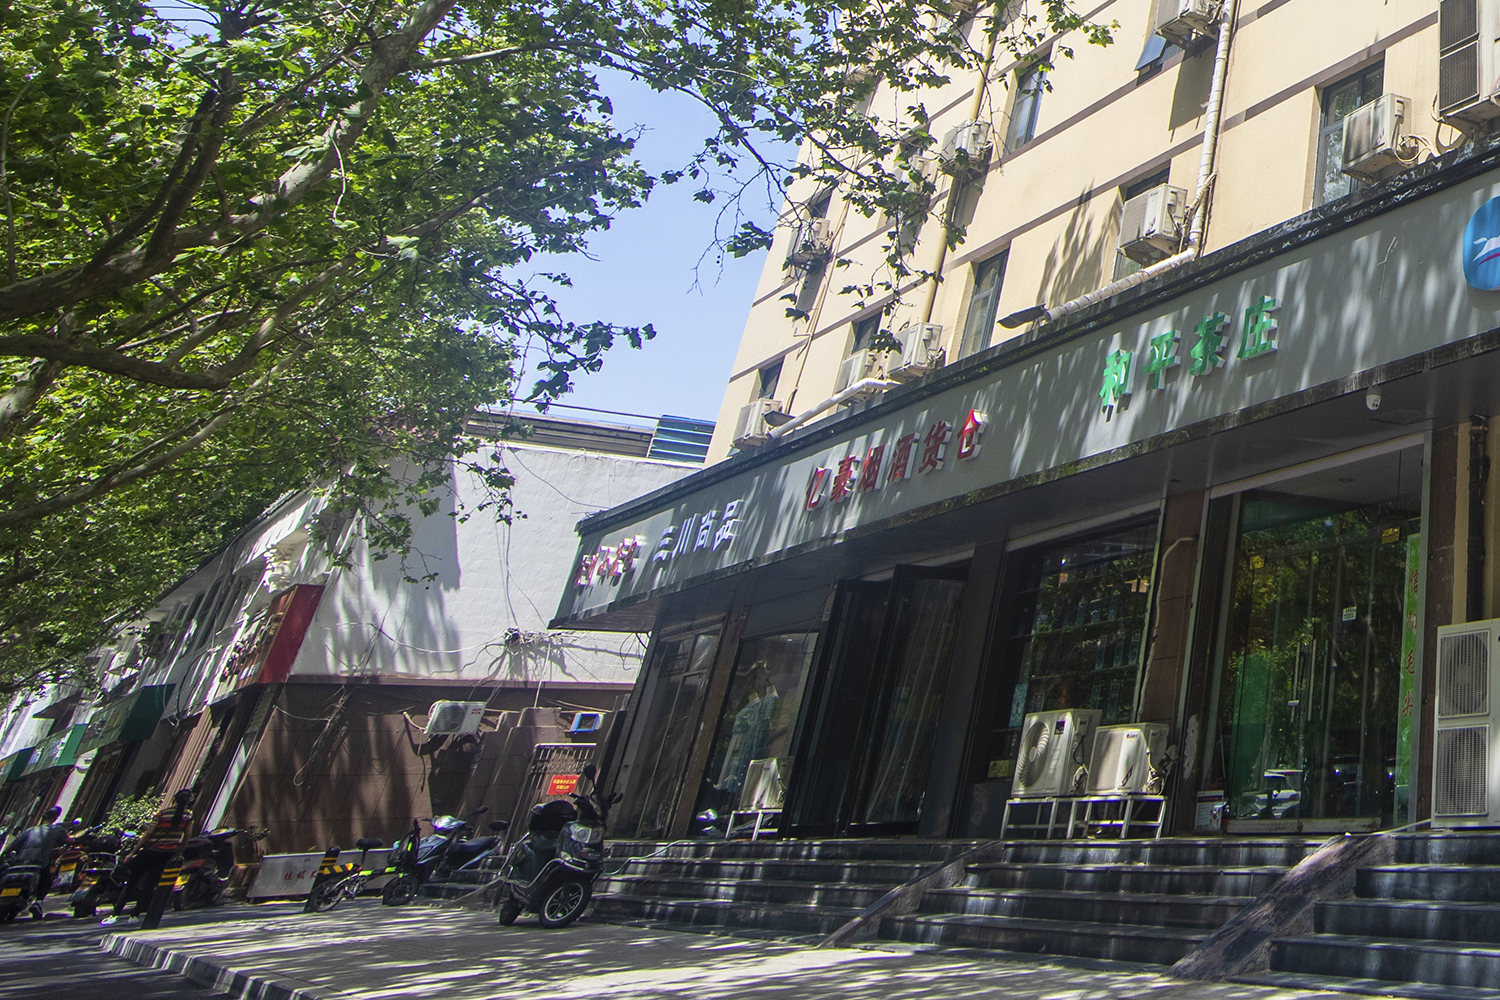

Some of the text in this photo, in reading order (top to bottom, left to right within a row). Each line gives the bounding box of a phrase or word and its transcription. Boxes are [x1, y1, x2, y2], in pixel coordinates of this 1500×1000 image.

[1099, 295, 1282, 407] 和平茶庄
[1402, 568, 1419, 718] 信阳毛尖
